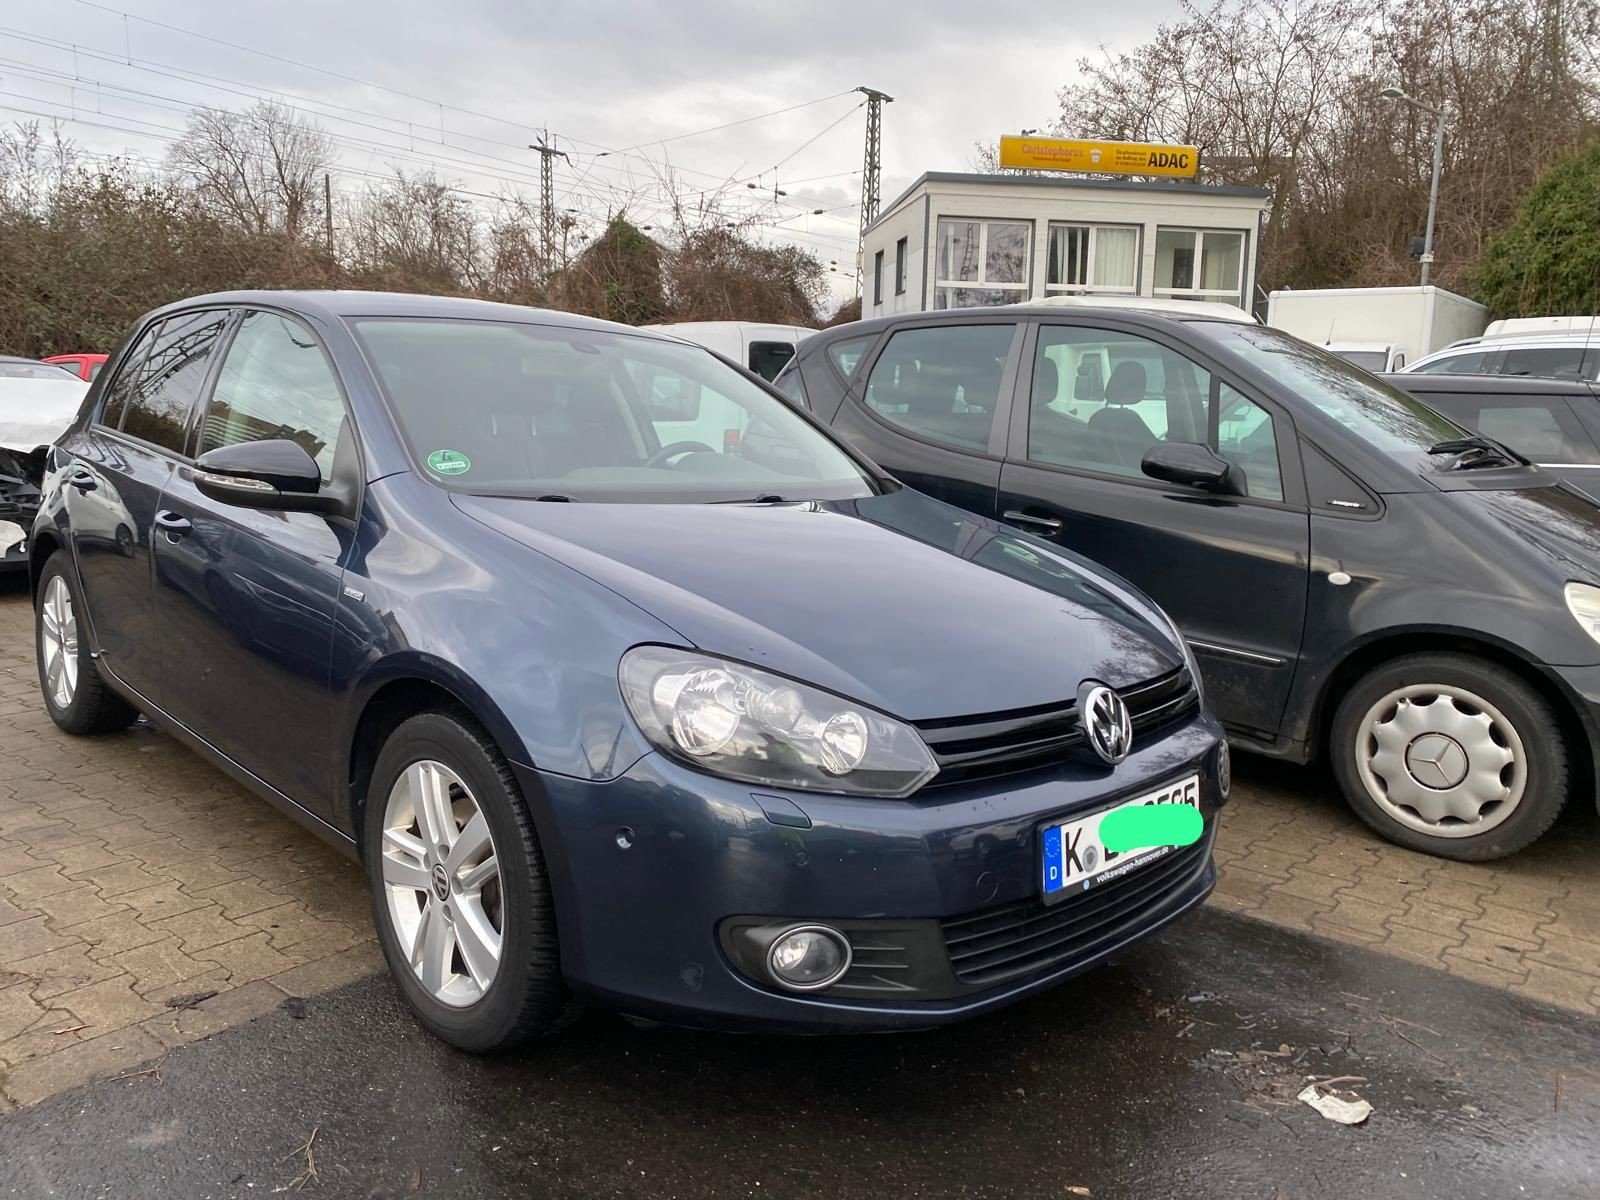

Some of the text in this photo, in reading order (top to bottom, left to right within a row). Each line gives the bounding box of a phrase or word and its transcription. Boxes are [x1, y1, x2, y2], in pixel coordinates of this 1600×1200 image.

[1147, 152, 1189, 169] ADAC
[1065, 827, 1083, 877] K
[1050, 866, 1058, 880] D
